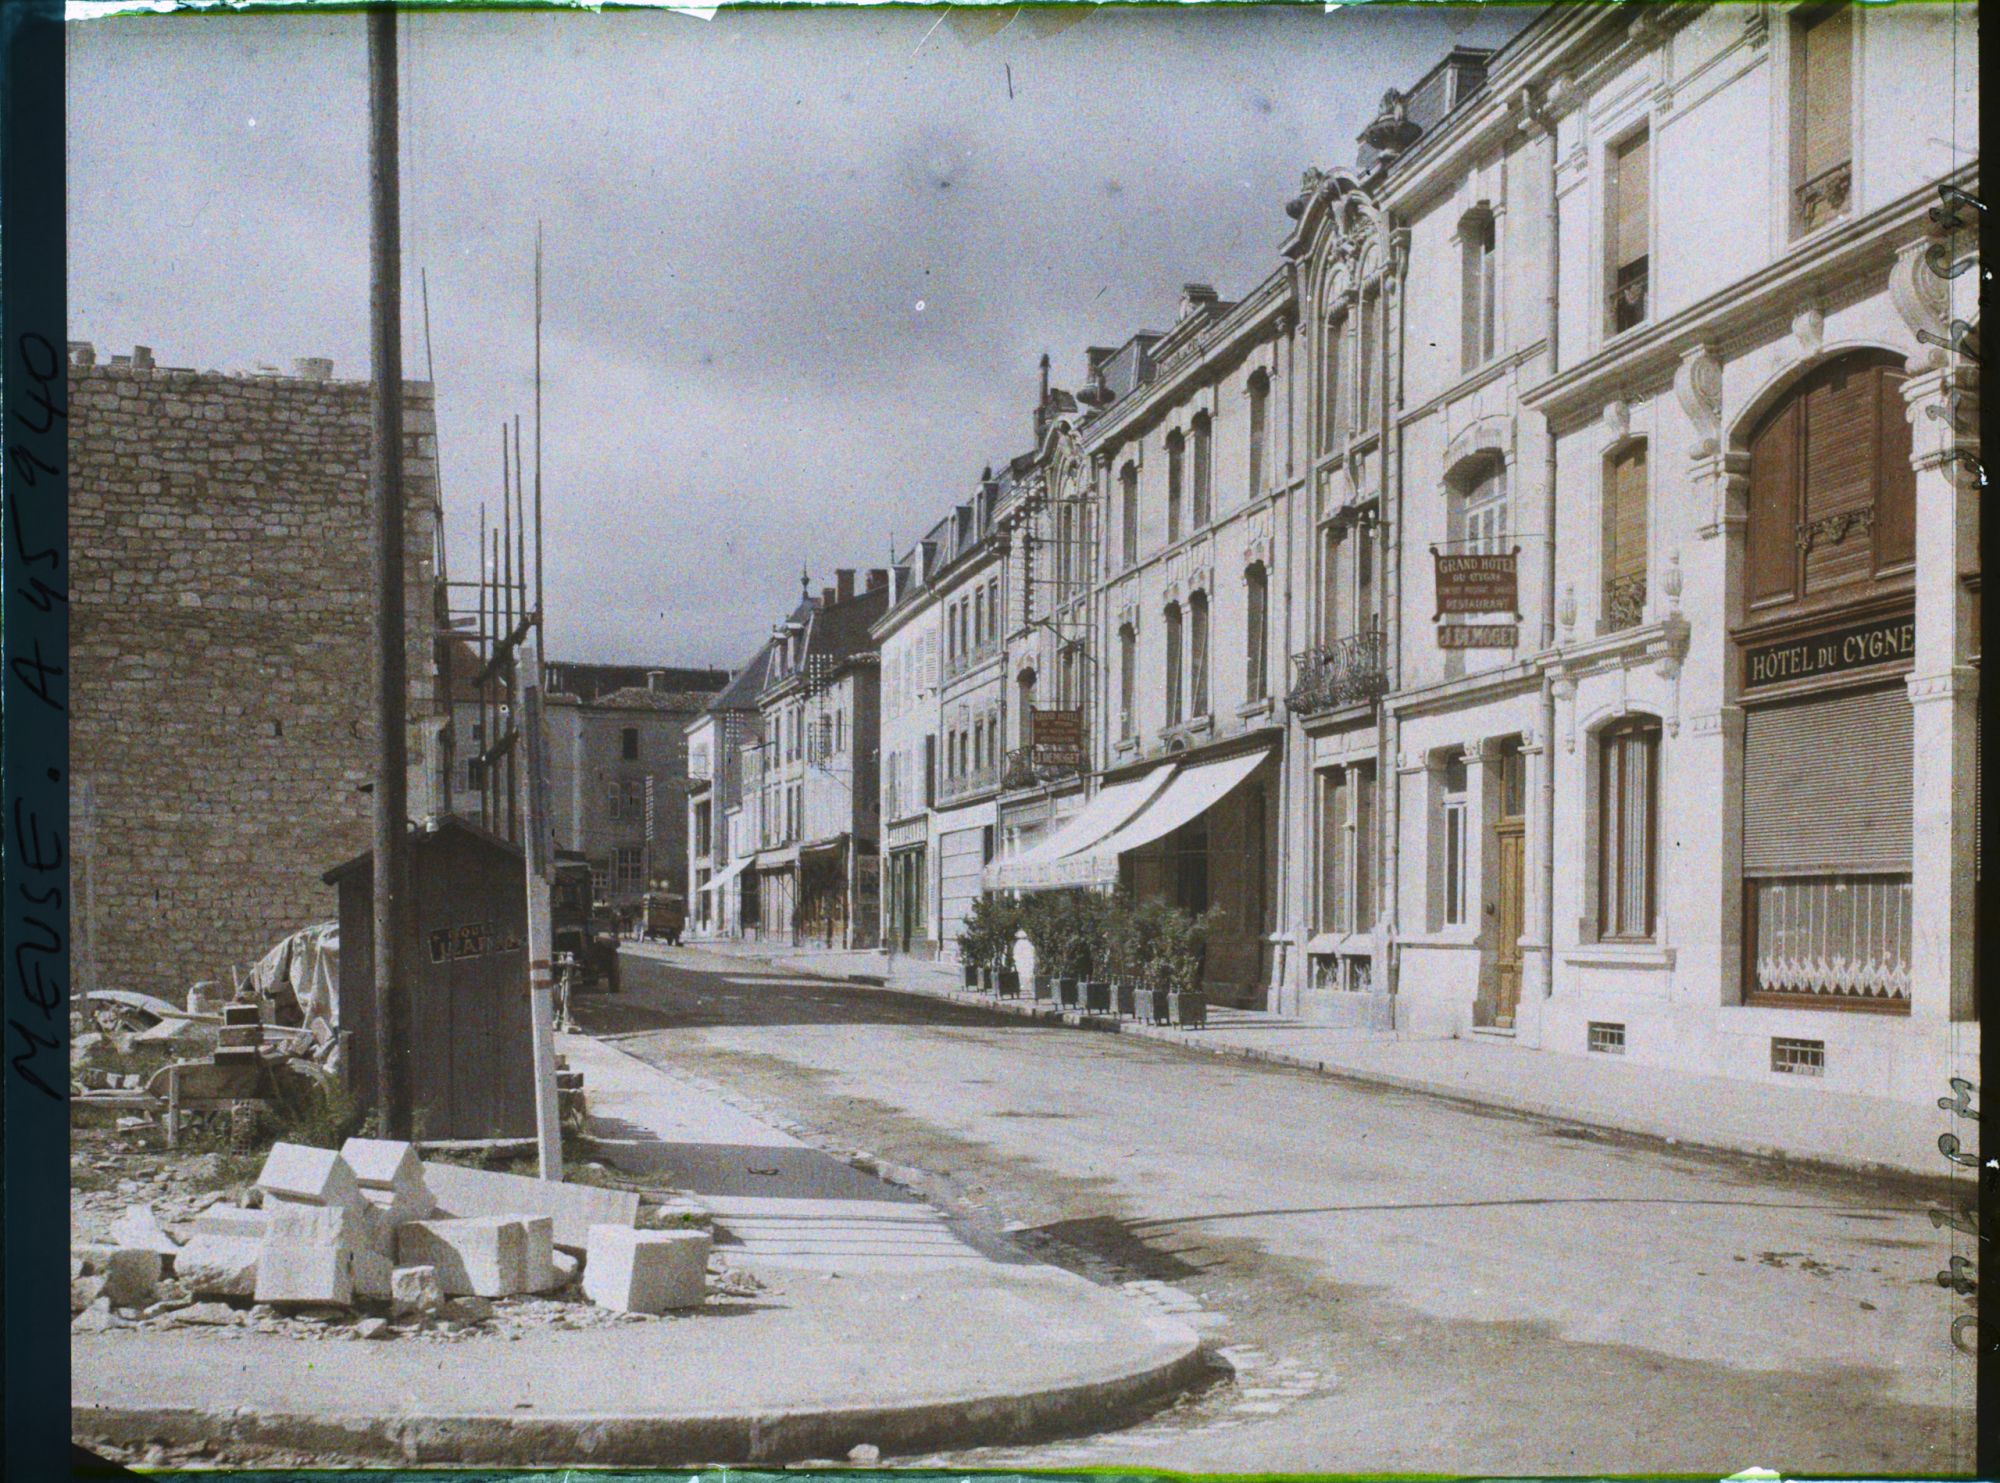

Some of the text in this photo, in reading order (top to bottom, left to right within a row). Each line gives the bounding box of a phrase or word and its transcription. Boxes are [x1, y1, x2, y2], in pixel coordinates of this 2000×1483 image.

[1439, 558, 1477, 574] GRAND
[1446, 598, 1510, 610] RESTAURANT
[1753, 623, 1914, 681] HÔTEL DU CYGNE
